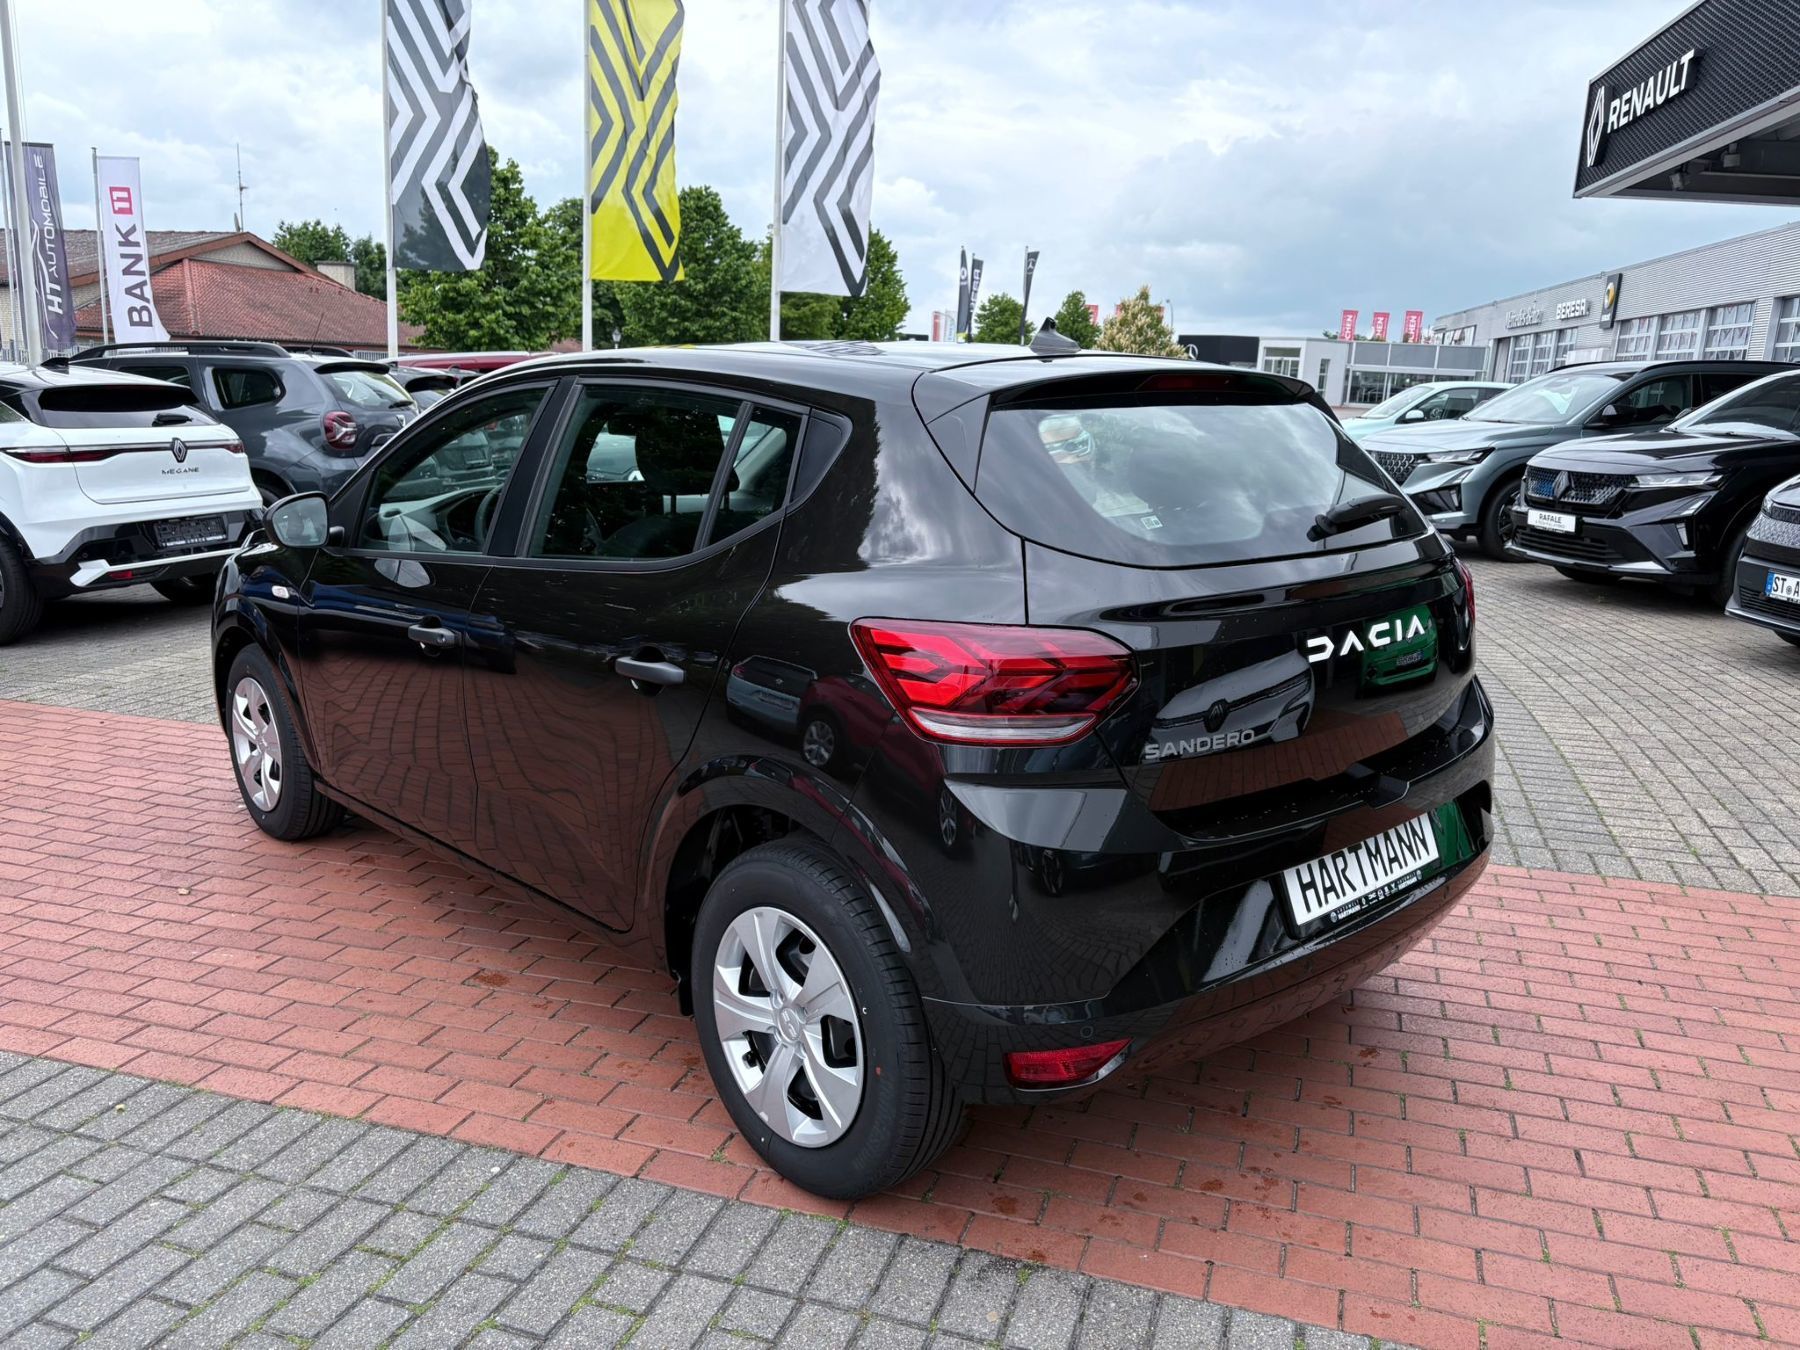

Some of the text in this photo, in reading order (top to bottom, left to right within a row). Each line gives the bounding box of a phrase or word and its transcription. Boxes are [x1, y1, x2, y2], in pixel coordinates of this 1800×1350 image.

[1606, 48, 1695, 134] RENAULT
[34, 153, 63, 315] HT AUTOMOBILE
[114, 223, 153, 328] BANK
[1556, 298, 1587, 320] BERESA
[161, 466, 200, 475] MEGANE
[1538, 513, 1563, 524] RAFALE
[1772, 576, 1787, 594] ST
[1306, 614, 1425, 663] DACIA
[1144, 729, 1256, 760] SANDERO
[1296, 816, 1431, 914] HARTMANN
